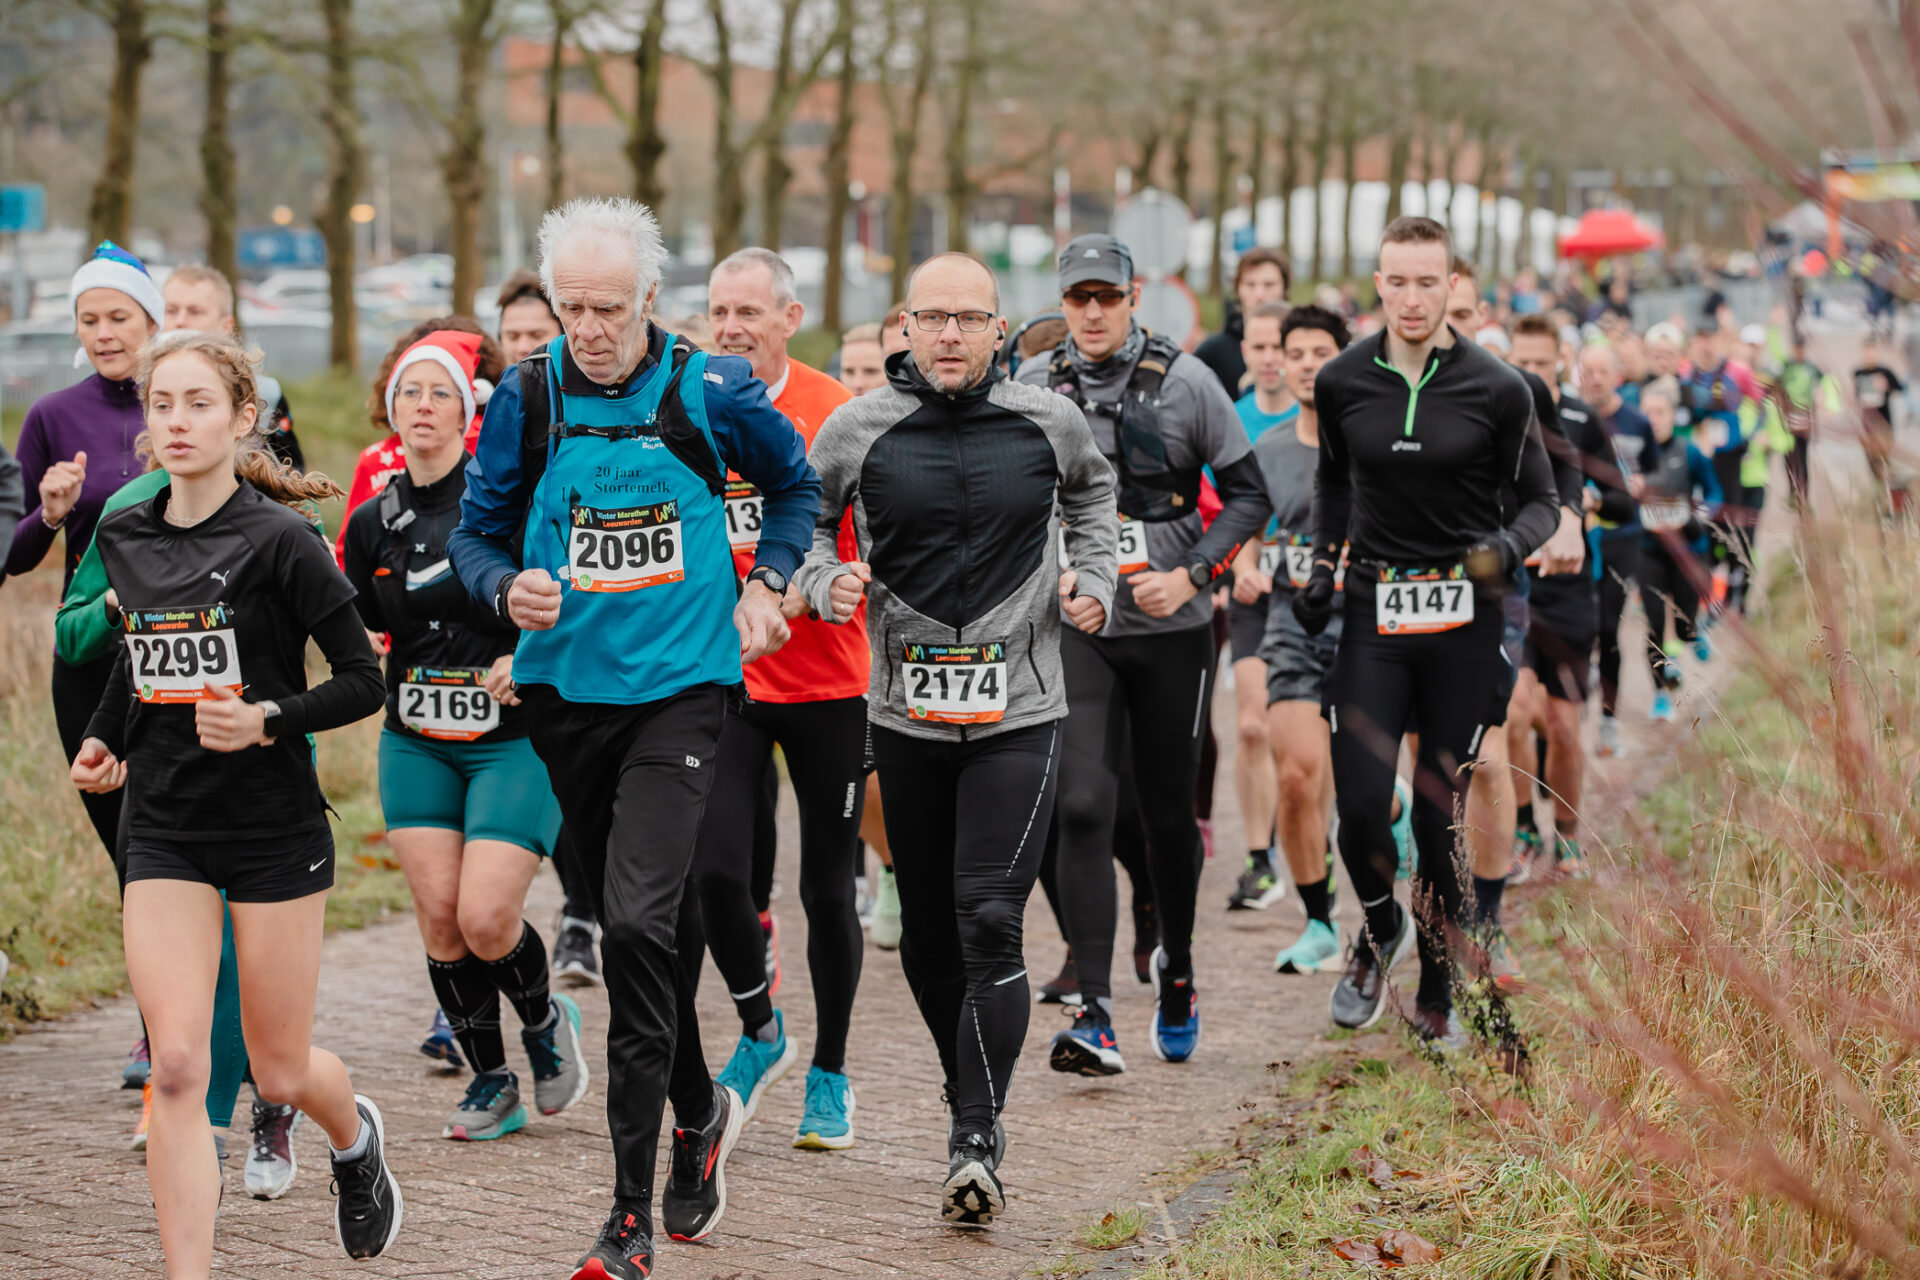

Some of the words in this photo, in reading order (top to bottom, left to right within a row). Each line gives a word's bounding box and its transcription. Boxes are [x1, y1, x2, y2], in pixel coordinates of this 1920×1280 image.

[595, 466, 611, 478] 20
[614, 466, 642, 480] jaar
[594, 481, 671, 494] Stortemelk
[617, 509, 650, 520] Marathon
[603, 518, 643, 528] Leeuwarden
[576, 527, 675, 571] 2096
[1384, 585, 1464, 615] 4147
[144, 614, 165, 622] Winter
[166, 612, 195, 621] Marathon
[152, 621, 188, 630] Leeuwarden
[133, 634, 228, 678] 2299
[910, 666, 1000, 702] 2174
[407, 688, 491, 721] 2169
